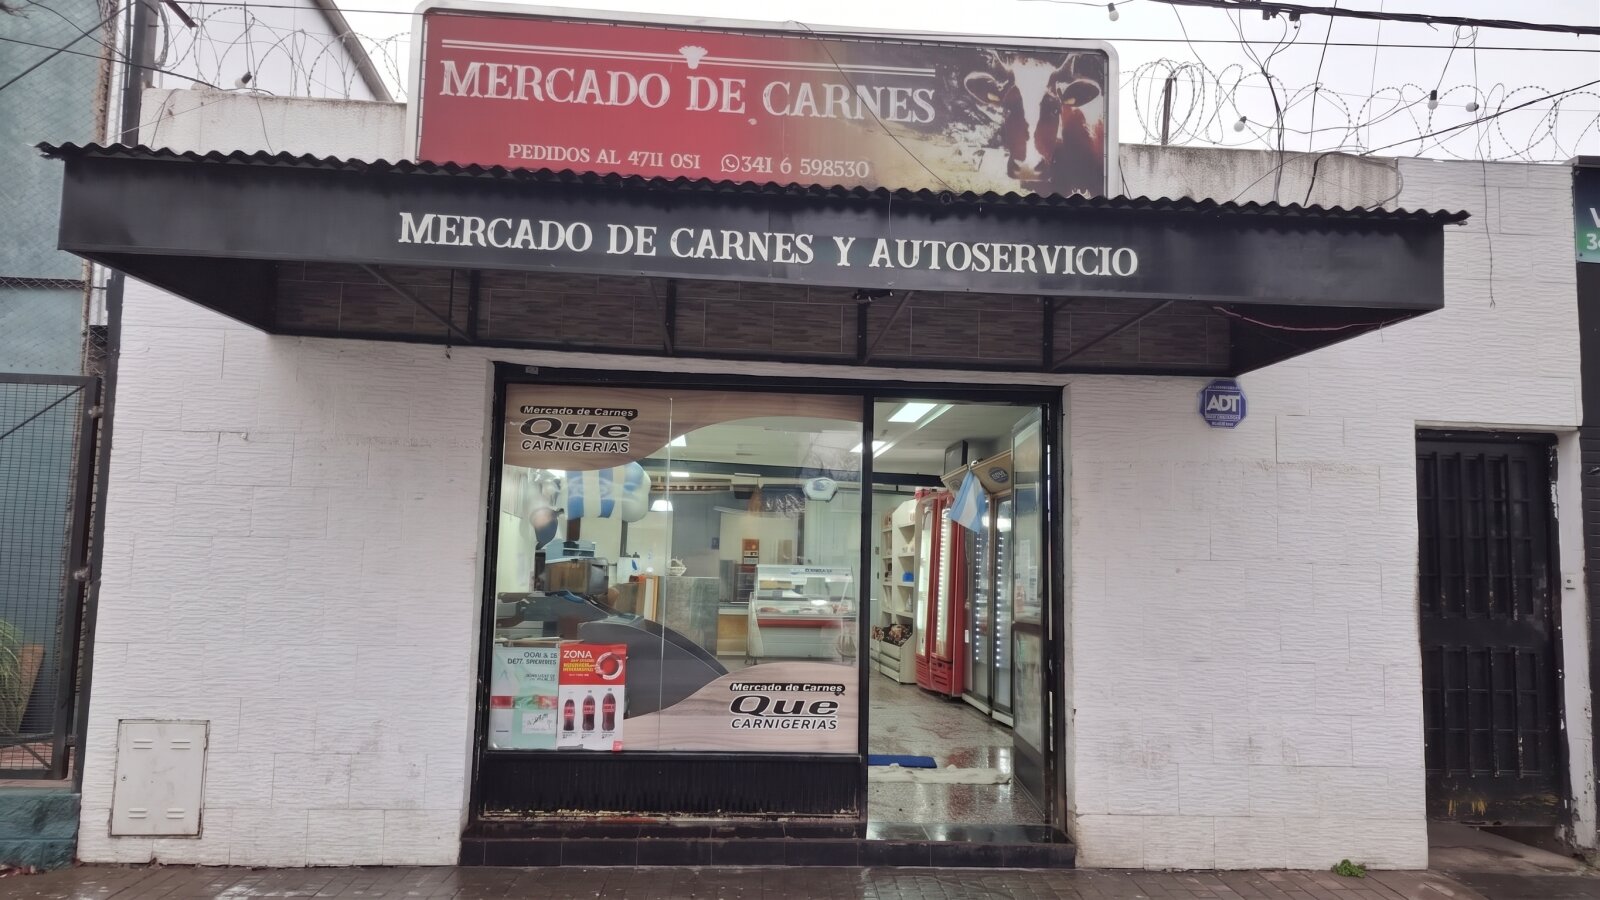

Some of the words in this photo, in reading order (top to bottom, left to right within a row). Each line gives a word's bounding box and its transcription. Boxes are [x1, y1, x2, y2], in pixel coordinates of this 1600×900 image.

[439, 60, 671, 108] MERCADO
[685, 75, 746, 114] DE
[762, 81, 936, 124] CARNES
[507, 143, 590, 163] PEDIDOS
[596, 149, 621, 165] AL
[780, 157, 792, 174] 6
[799, 158, 870, 178] 598530
[398, 212, 593, 252] MERCADO
[606, 223, 657, 256] DE
[670, 227, 814, 264] CARNES
[832, 236, 855, 267] Y
[868, 238, 1138, 276] AUTOSERVICIO
[523, 406, 574, 415] Mercado
[576, 407, 591, 416] de
[594, 408, 634, 417] Carnes
[1206, 394, 1240, 413] ADT
[520, 416, 631, 440] Que
[563, 650, 593, 659] ZONA
[731, 683, 782, 692] Mercado
[785, 683, 800, 692] de
[802, 684, 843, 692] Carnes
[729, 694, 839, 717] Que
